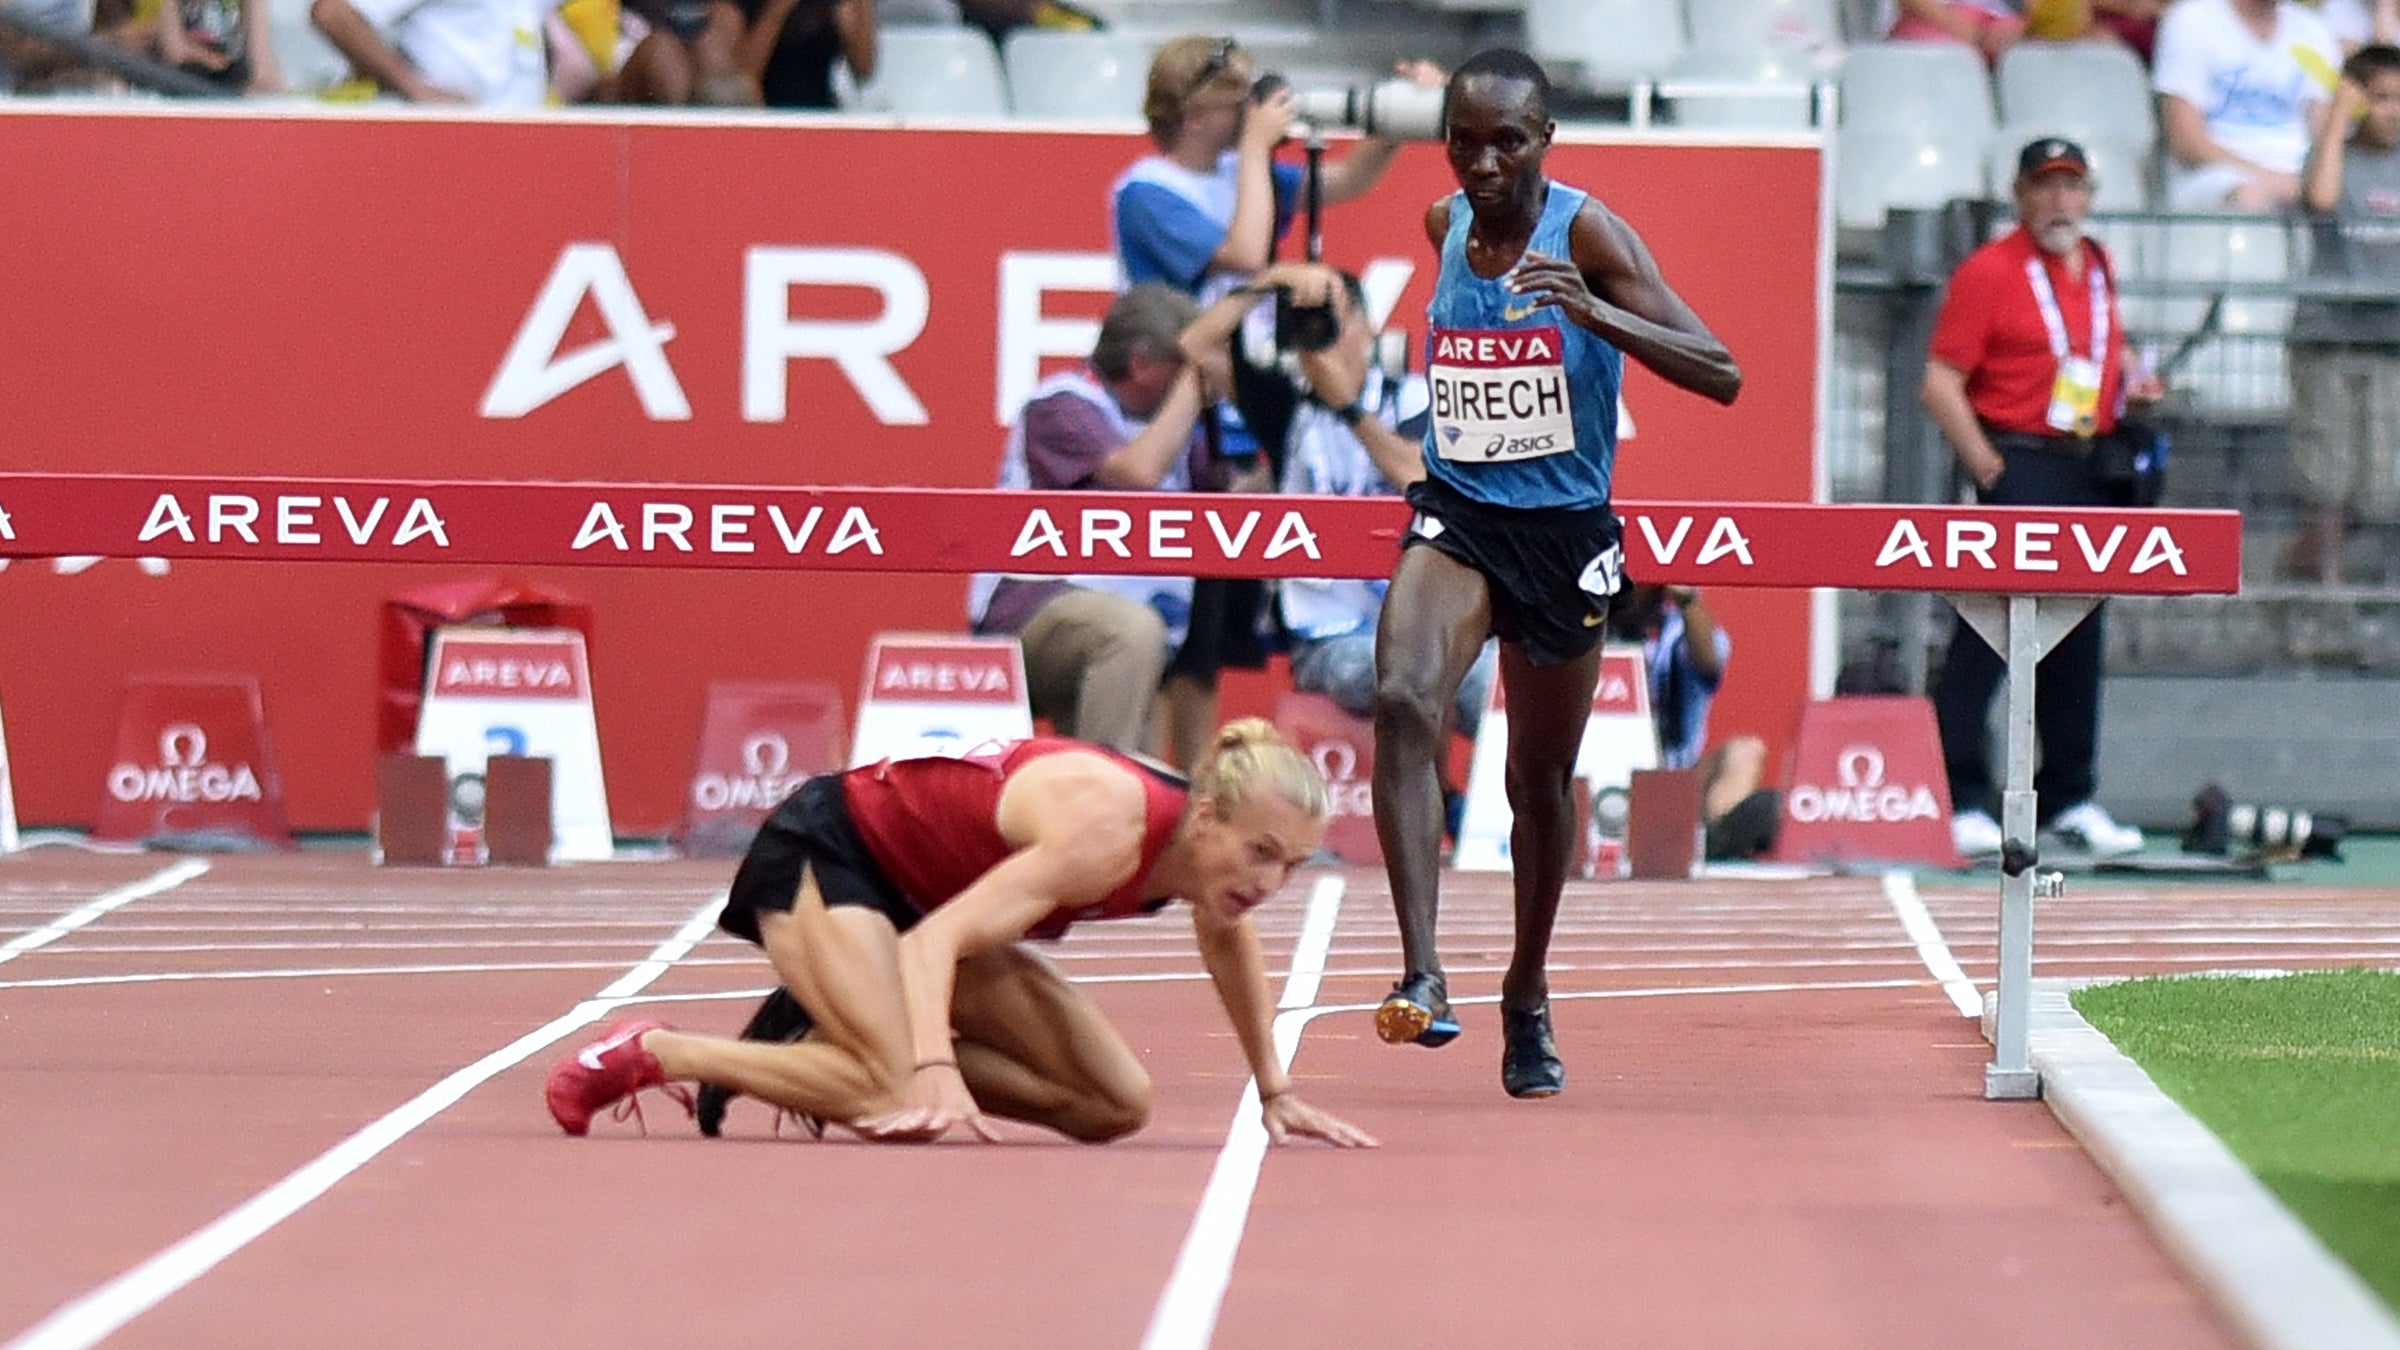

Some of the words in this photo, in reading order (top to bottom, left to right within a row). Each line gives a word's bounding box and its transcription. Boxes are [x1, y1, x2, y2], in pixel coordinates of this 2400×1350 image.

[1437, 335, 1552, 362] AREVA
[1435, 376, 1563, 421] BIRECH
[1506, 434, 1554, 453] asics
[138, 494, 450, 547] AREVA
[571, 502, 884, 555] AREVA
[1010, 508, 1322, 560] AREVA
[1875, 519, 2187, 576] AREVA
[445, 658, 571, 687] AREVA
[881, 663, 1009, 692] AREVA
[108, 763, 262, 801] OMEGA
[1789, 785, 1942, 823] OMEGA
